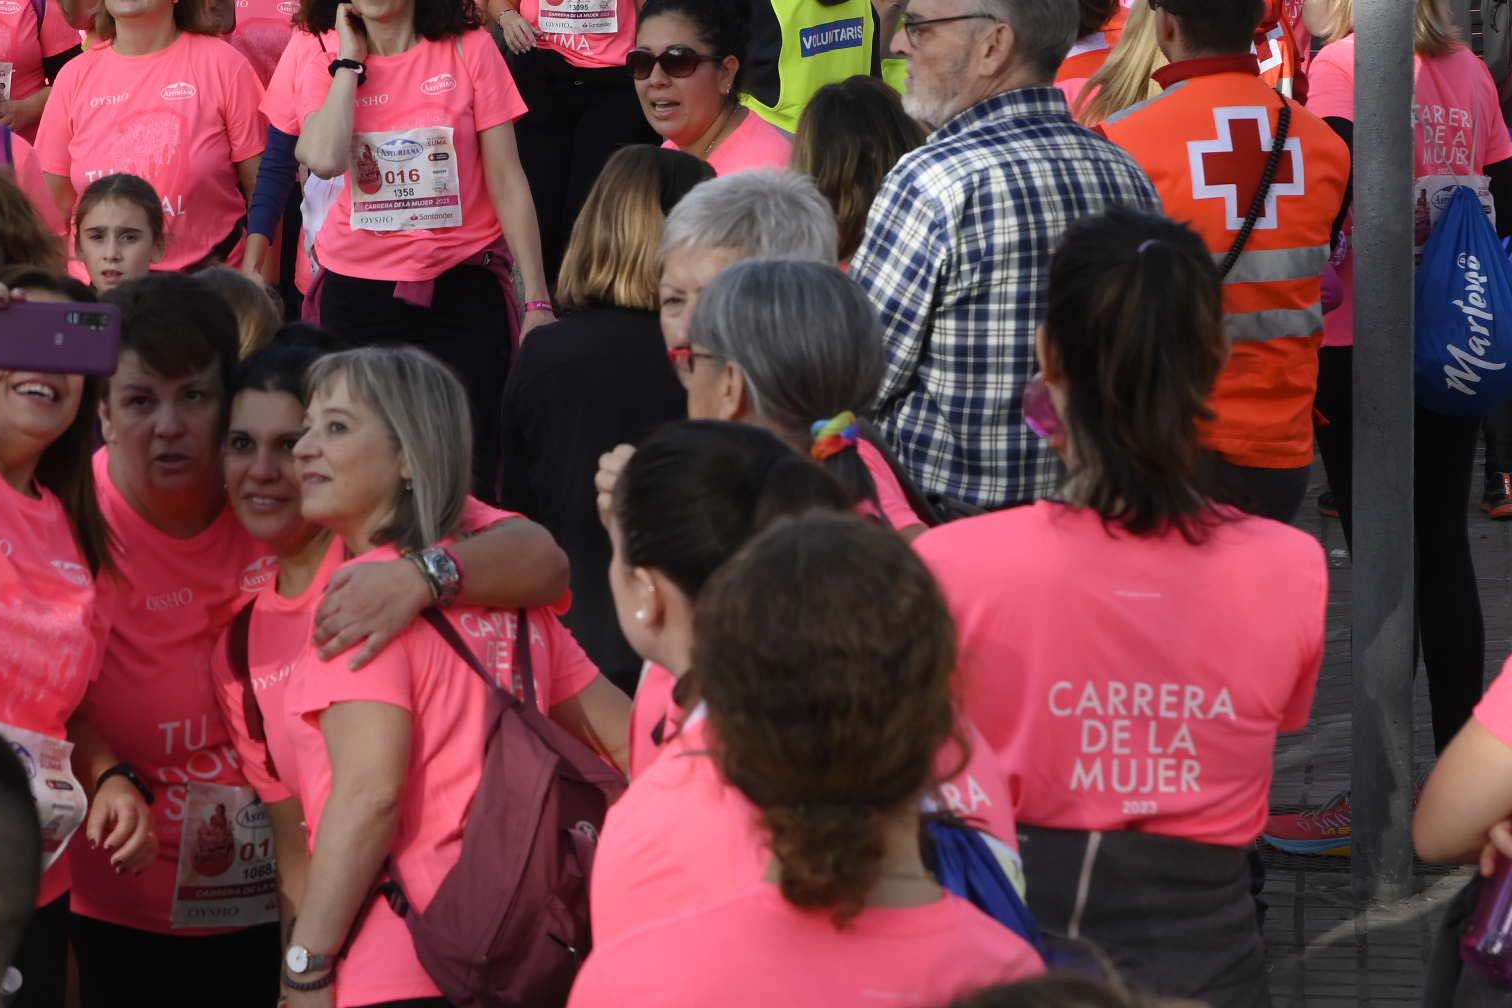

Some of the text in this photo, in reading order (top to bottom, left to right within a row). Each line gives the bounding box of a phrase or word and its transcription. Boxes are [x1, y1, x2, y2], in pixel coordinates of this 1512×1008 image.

[90, 93, 130, 108] OYSHO
[384, 168, 421, 185] 016
[393, 188, 415, 198] 1358
[364, 201, 393, 210] CARRERA
[411, 200, 434, 208] MUJER
[360, 212, 455, 224] OYSHO Santander
[1048, 680, 1237, 720] CARRERA
[158, 713, 208, 755] TU
[1080, 719, 1197, 756] DE LA
[1069, 758, 1201, 793] MUJER
[1122, 799, 1158, 815] 2023
[240, 838, 271, 863] 01
